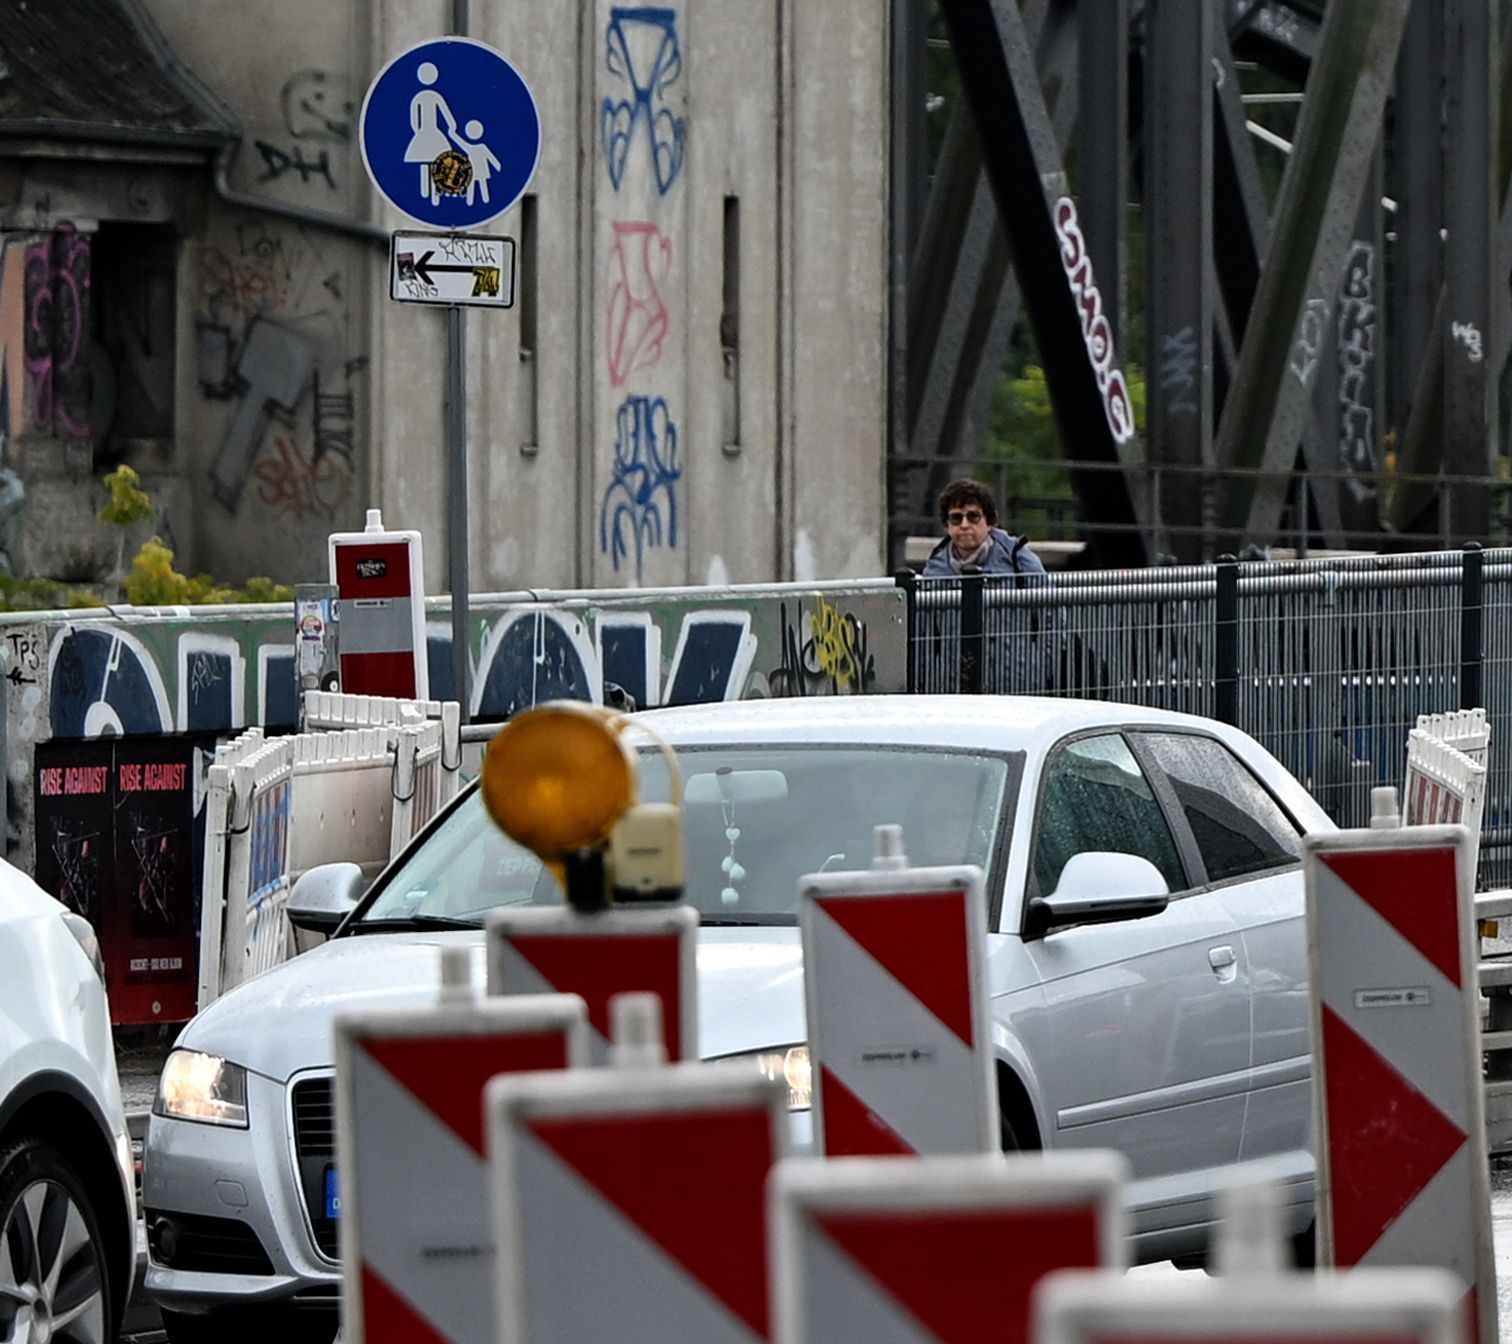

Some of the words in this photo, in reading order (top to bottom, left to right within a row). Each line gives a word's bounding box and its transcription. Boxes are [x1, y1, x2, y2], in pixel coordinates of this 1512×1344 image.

[40, 768, 63, 796] RISE
[64, 766, 108, 795] AGAINST
[120, 765, 142, 791] RISE
[143, 763, 187, 791] AGAINST
